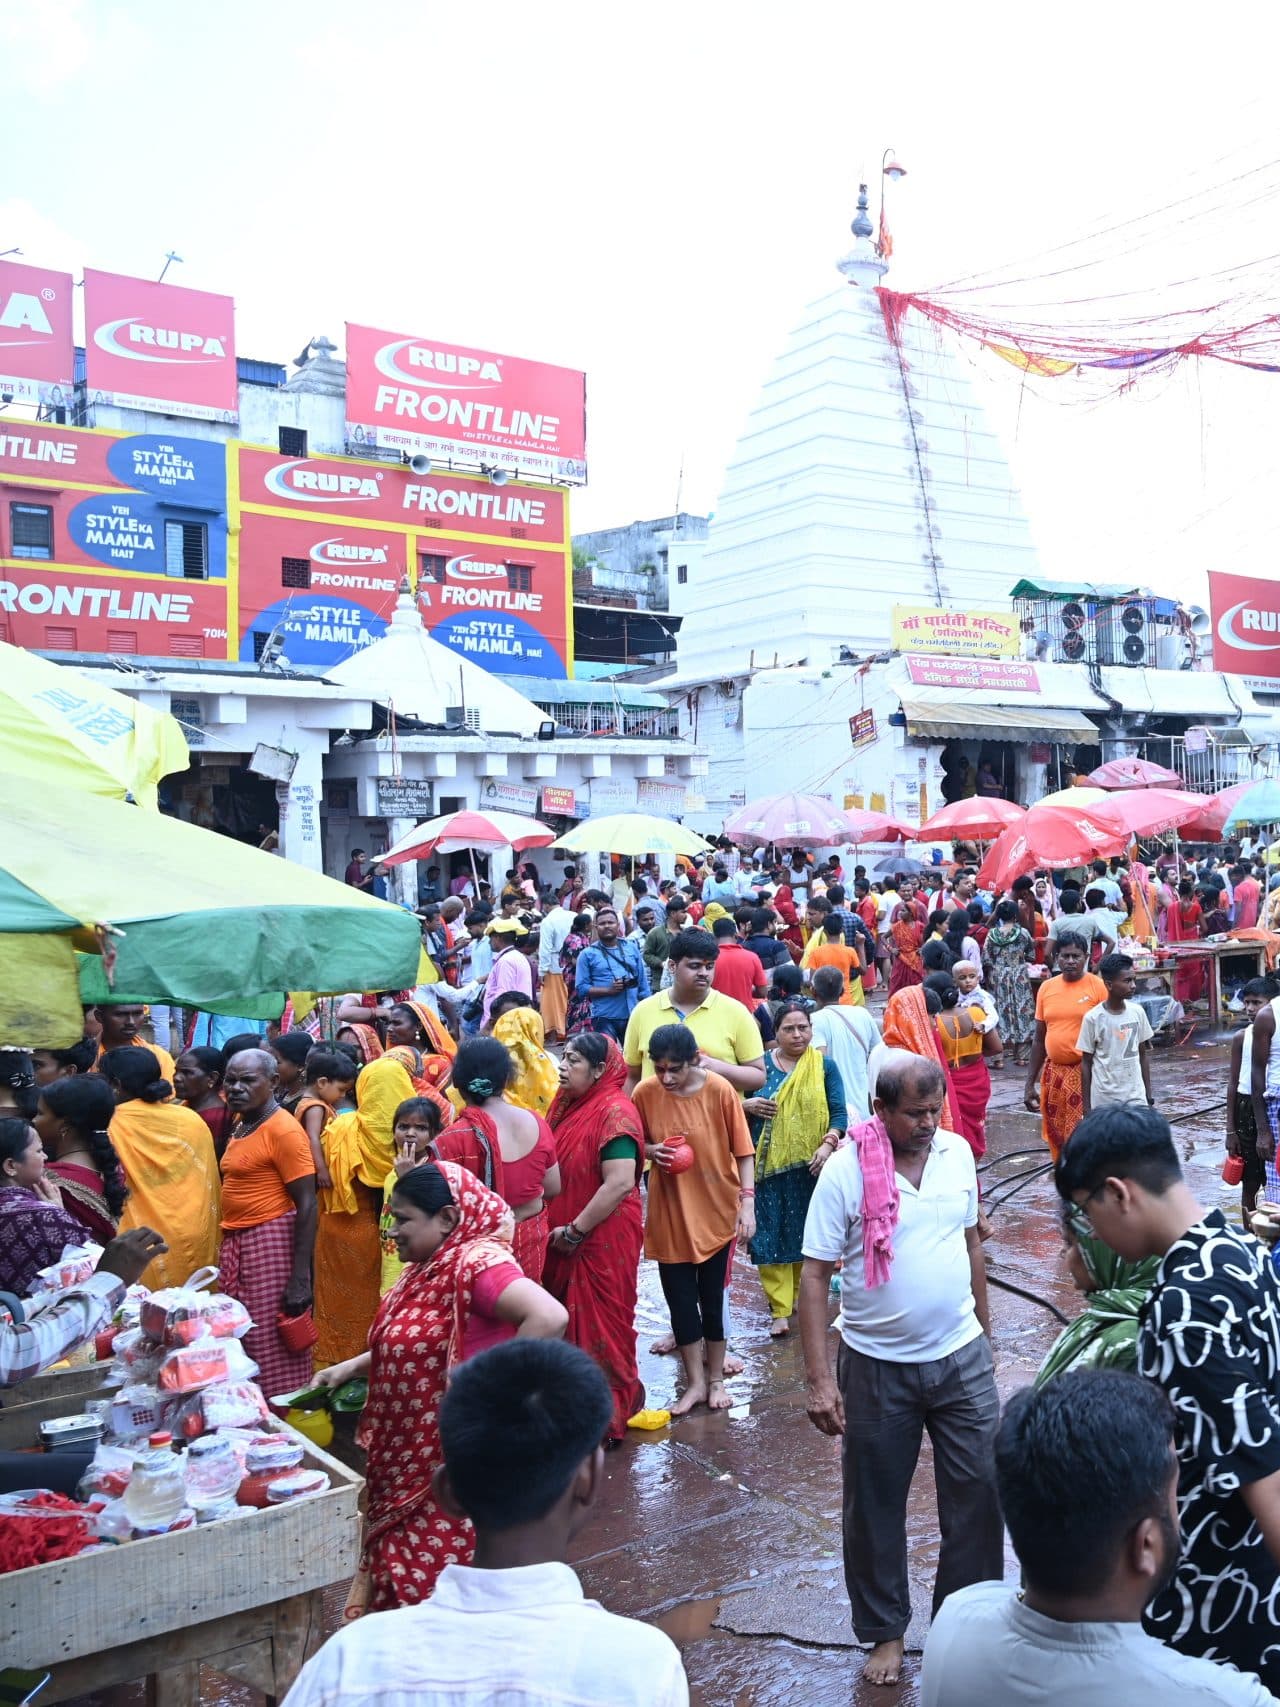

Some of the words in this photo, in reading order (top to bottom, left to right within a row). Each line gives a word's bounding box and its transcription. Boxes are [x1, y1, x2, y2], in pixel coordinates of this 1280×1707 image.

[129, 323, 226, 357] RUPA
[408, 346, 503, 383] RUPA
[375, 385, 560, 441] FRONTLINE
[159, 445, 174, 453] YEH
[476, 433, 502, 443] STYLE
[514, 439, 545, 449] MAMLA
[133, 450, 182, 467] STYLE
[183, 460, 194, 469] KA
[135, 463, 195, 481] MAMLA
[293, 470, 380, 498] RUPA
[112, 505, 130, 515] YEH
[402, 484, 545, 525] FRONTLINE
[86, 514, 139, 532] STYLE
[139, 523, 153, 535] KA
[86, 530, 155, 550] MAMLA
[327, 544, 387, 563] RUPA
[460, 560, 508, 577] RUPA
[310, 572, 396, 592] FRONTLINE
[441, 586, 543, 612] FRONTLINE
[310, 606, 361, 626] STYLE
[924, 613, 968, 627] पार्वती
[971, 618, 1012, 637] मन्दिर
[284, 622, 302, 633] KA
[304, 624, 370, 644] MAMLA
[452, 625, 468, 635] YEH
[469, 621, 514, 639] STYLE
[448, 635, 463, 645] KA
[464, 639, 522, 656] MAMLA
